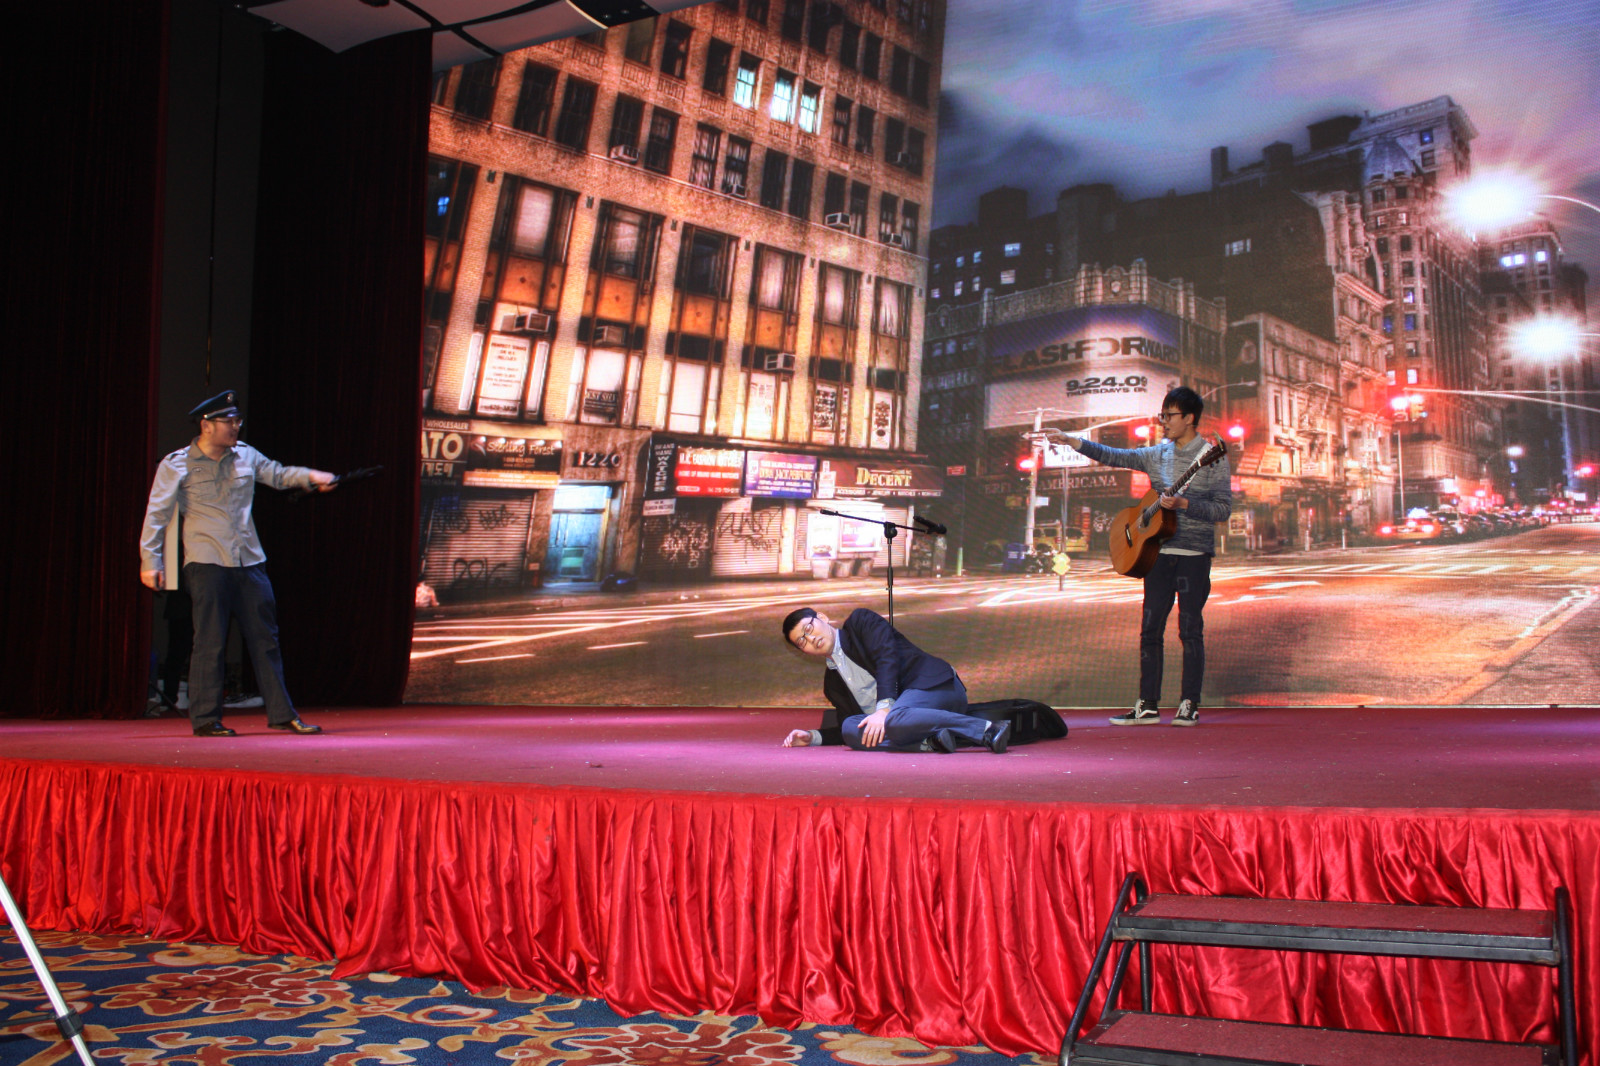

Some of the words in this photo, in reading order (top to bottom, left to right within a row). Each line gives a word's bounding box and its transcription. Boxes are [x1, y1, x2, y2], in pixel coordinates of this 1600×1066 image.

[426, 420, 469, 430] WHOLESALER
[486, 440, 526, 457] Sterling
[528, 444, 556, 456] Forest
[578, 451, 621, 468] 1220
[856, 467, 913, 487] DECENT
